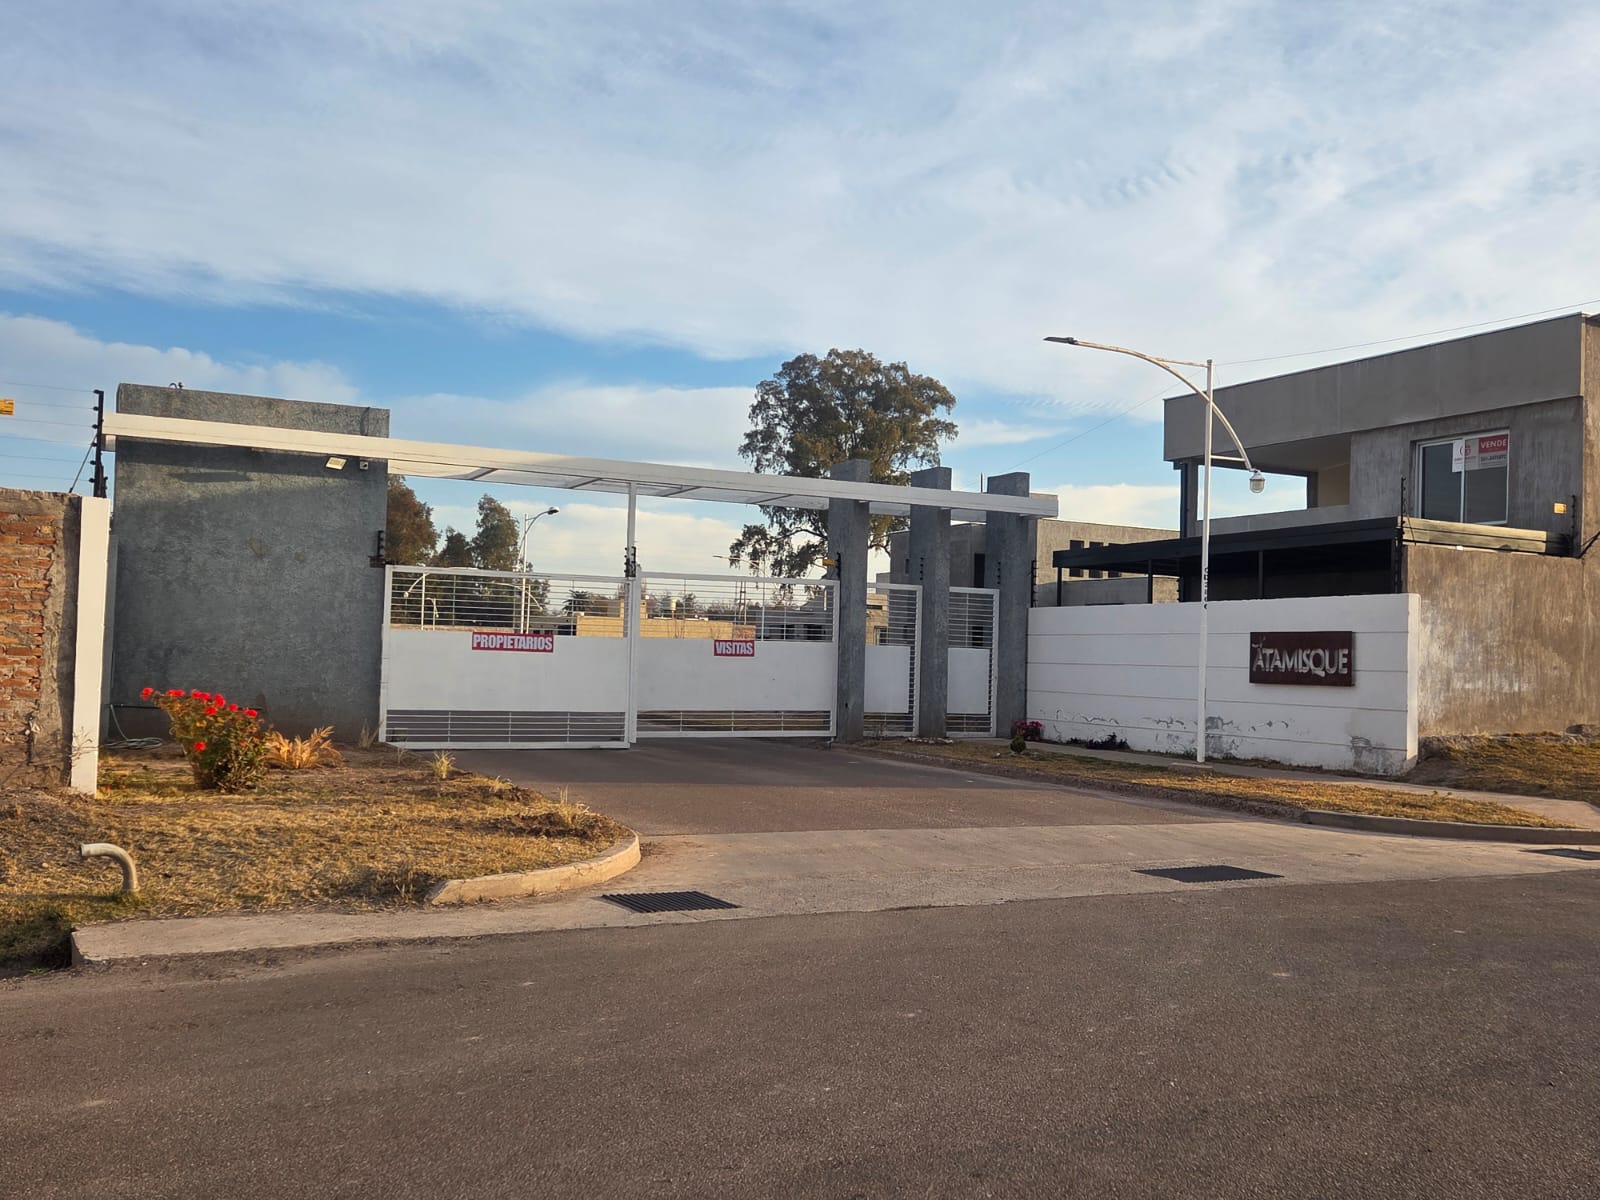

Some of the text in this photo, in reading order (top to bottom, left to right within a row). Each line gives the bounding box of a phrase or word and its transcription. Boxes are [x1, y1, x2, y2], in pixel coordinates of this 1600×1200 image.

[1480, 439, 1507, 448] VENDE
[472, 634, 552, 650] PROPIETARIOS
[715, 641, 754, 655] VISITAS
[1252, 647, 1349, 677] ATAMISQUE
